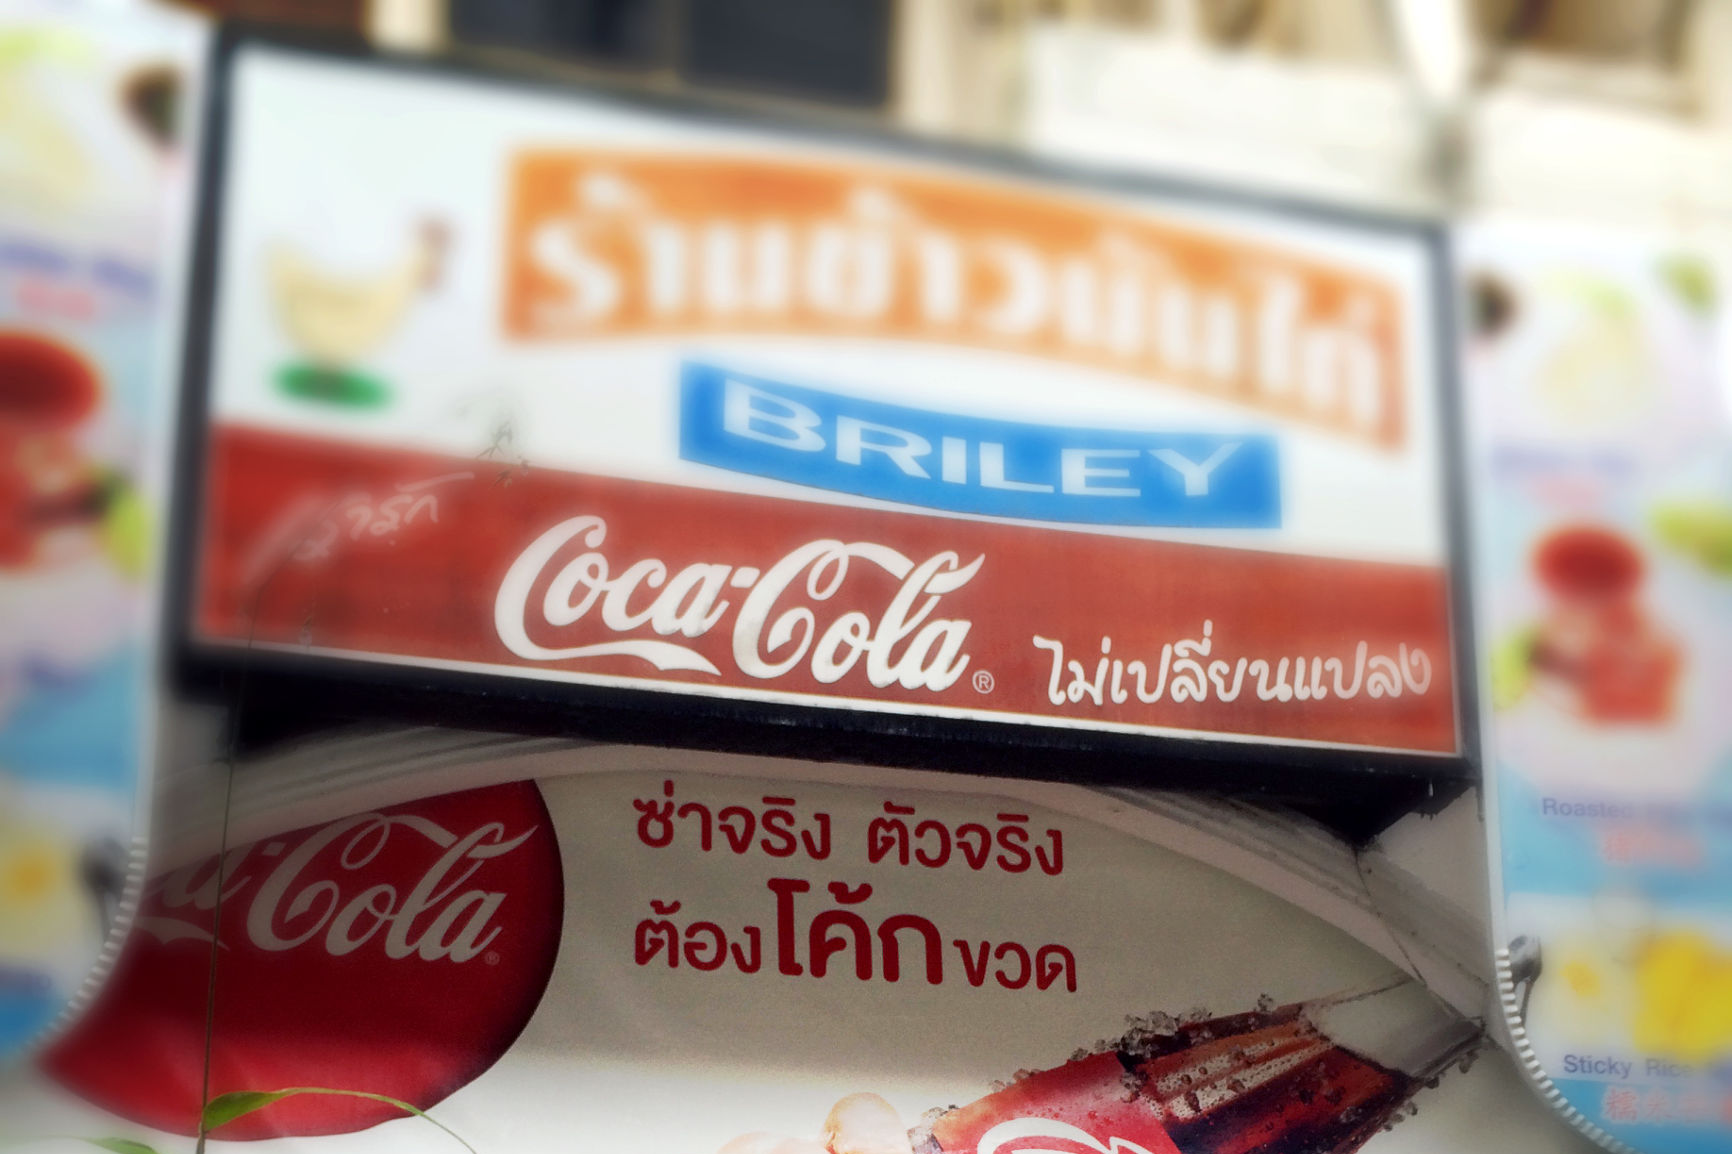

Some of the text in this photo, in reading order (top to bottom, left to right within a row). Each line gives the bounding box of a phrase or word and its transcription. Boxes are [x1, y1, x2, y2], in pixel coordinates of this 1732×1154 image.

[723, 377, 1243, 498] BRILEY
[494, 514, 986, 692] Coca-Cola
[1032, 619, 1432, 706] ไม่เปลี่ยนแปลง
[633, 779, 1064, 876] ซ่าจริง ตัวจริง
[634, 877, 1078, 993] ต้องโค้กขวด
[1563, 1054, 1632, 1079] Sticky
